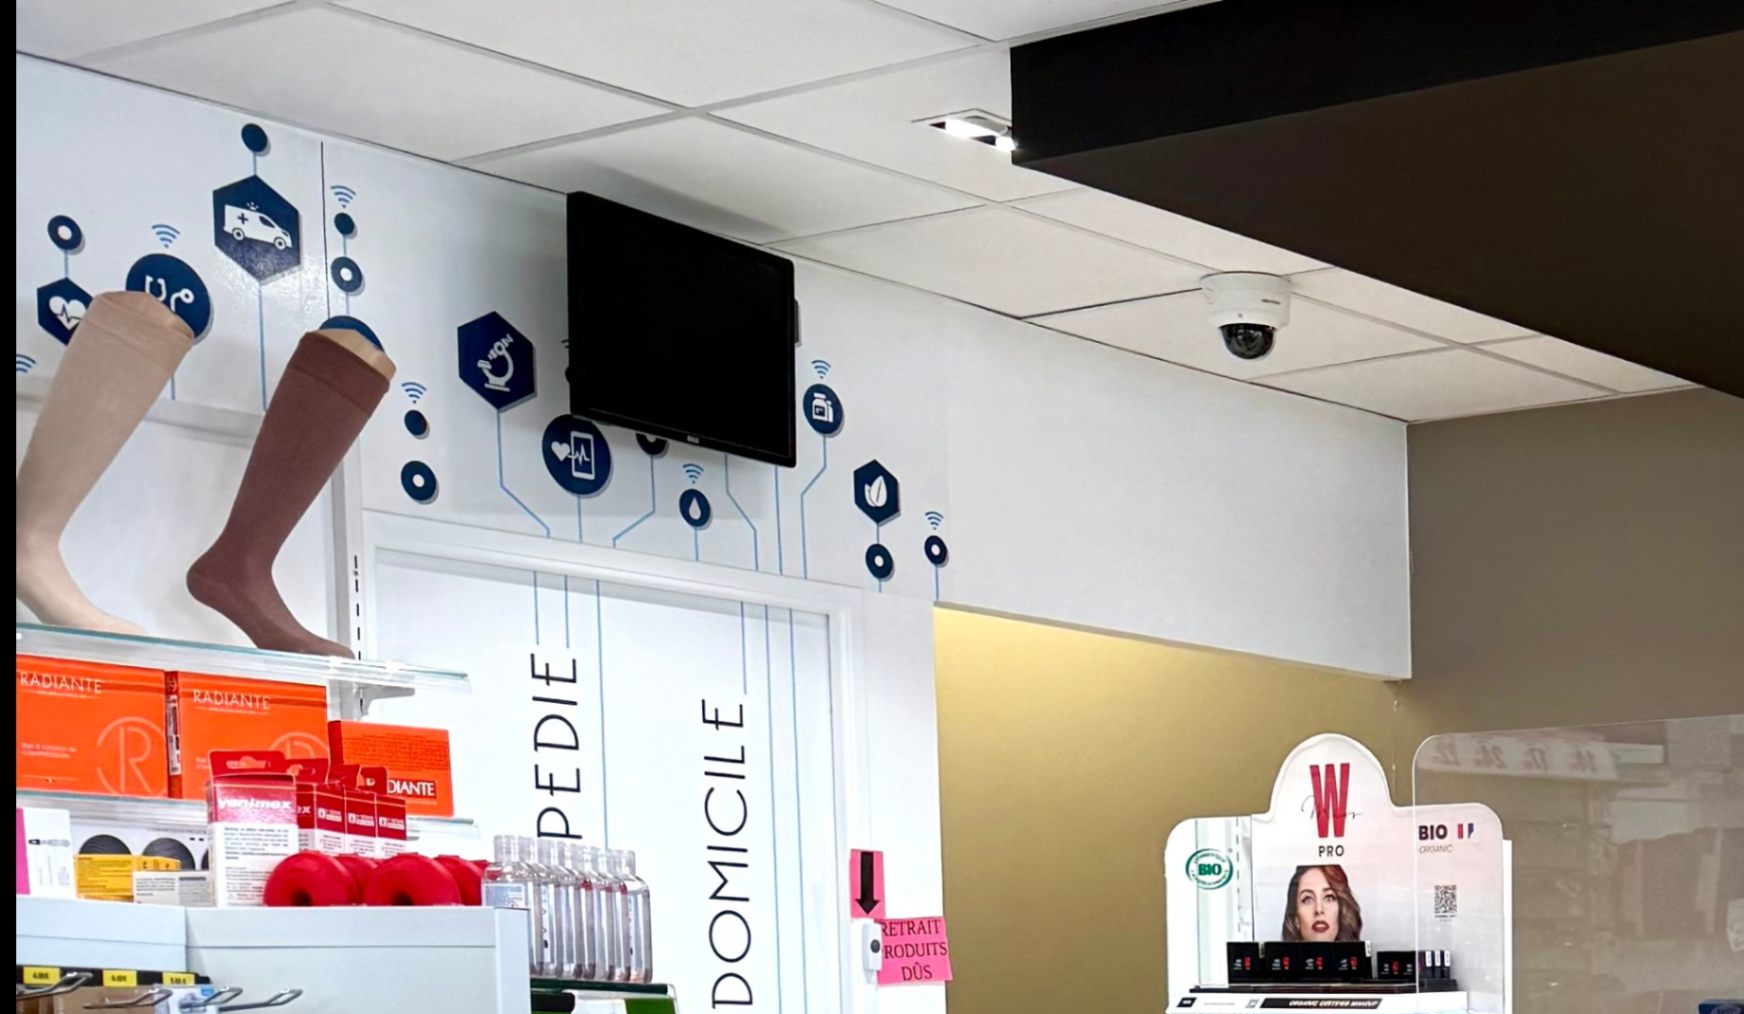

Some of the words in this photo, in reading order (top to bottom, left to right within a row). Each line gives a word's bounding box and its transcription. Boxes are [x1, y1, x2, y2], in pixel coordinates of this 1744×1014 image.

[20, 671, 103, 695] RADIANTE
[193, 688, 271, 711] RADIANTE
[386, 780, 436, 797] DIANTE
[1309, 763, 1350, 838] W
[1418, 824, 1448, 841] BIO
[702, 699, 752, 1008] DOMICILE
[1318, 845, 1345, 857] PRO
[1198, 862, 1222, 876] BIO
[881, 919, 941, 937] RETRAIT
[883, 941, 948, 960] RODUITS
[901, 962, 933, 981] DÛS
